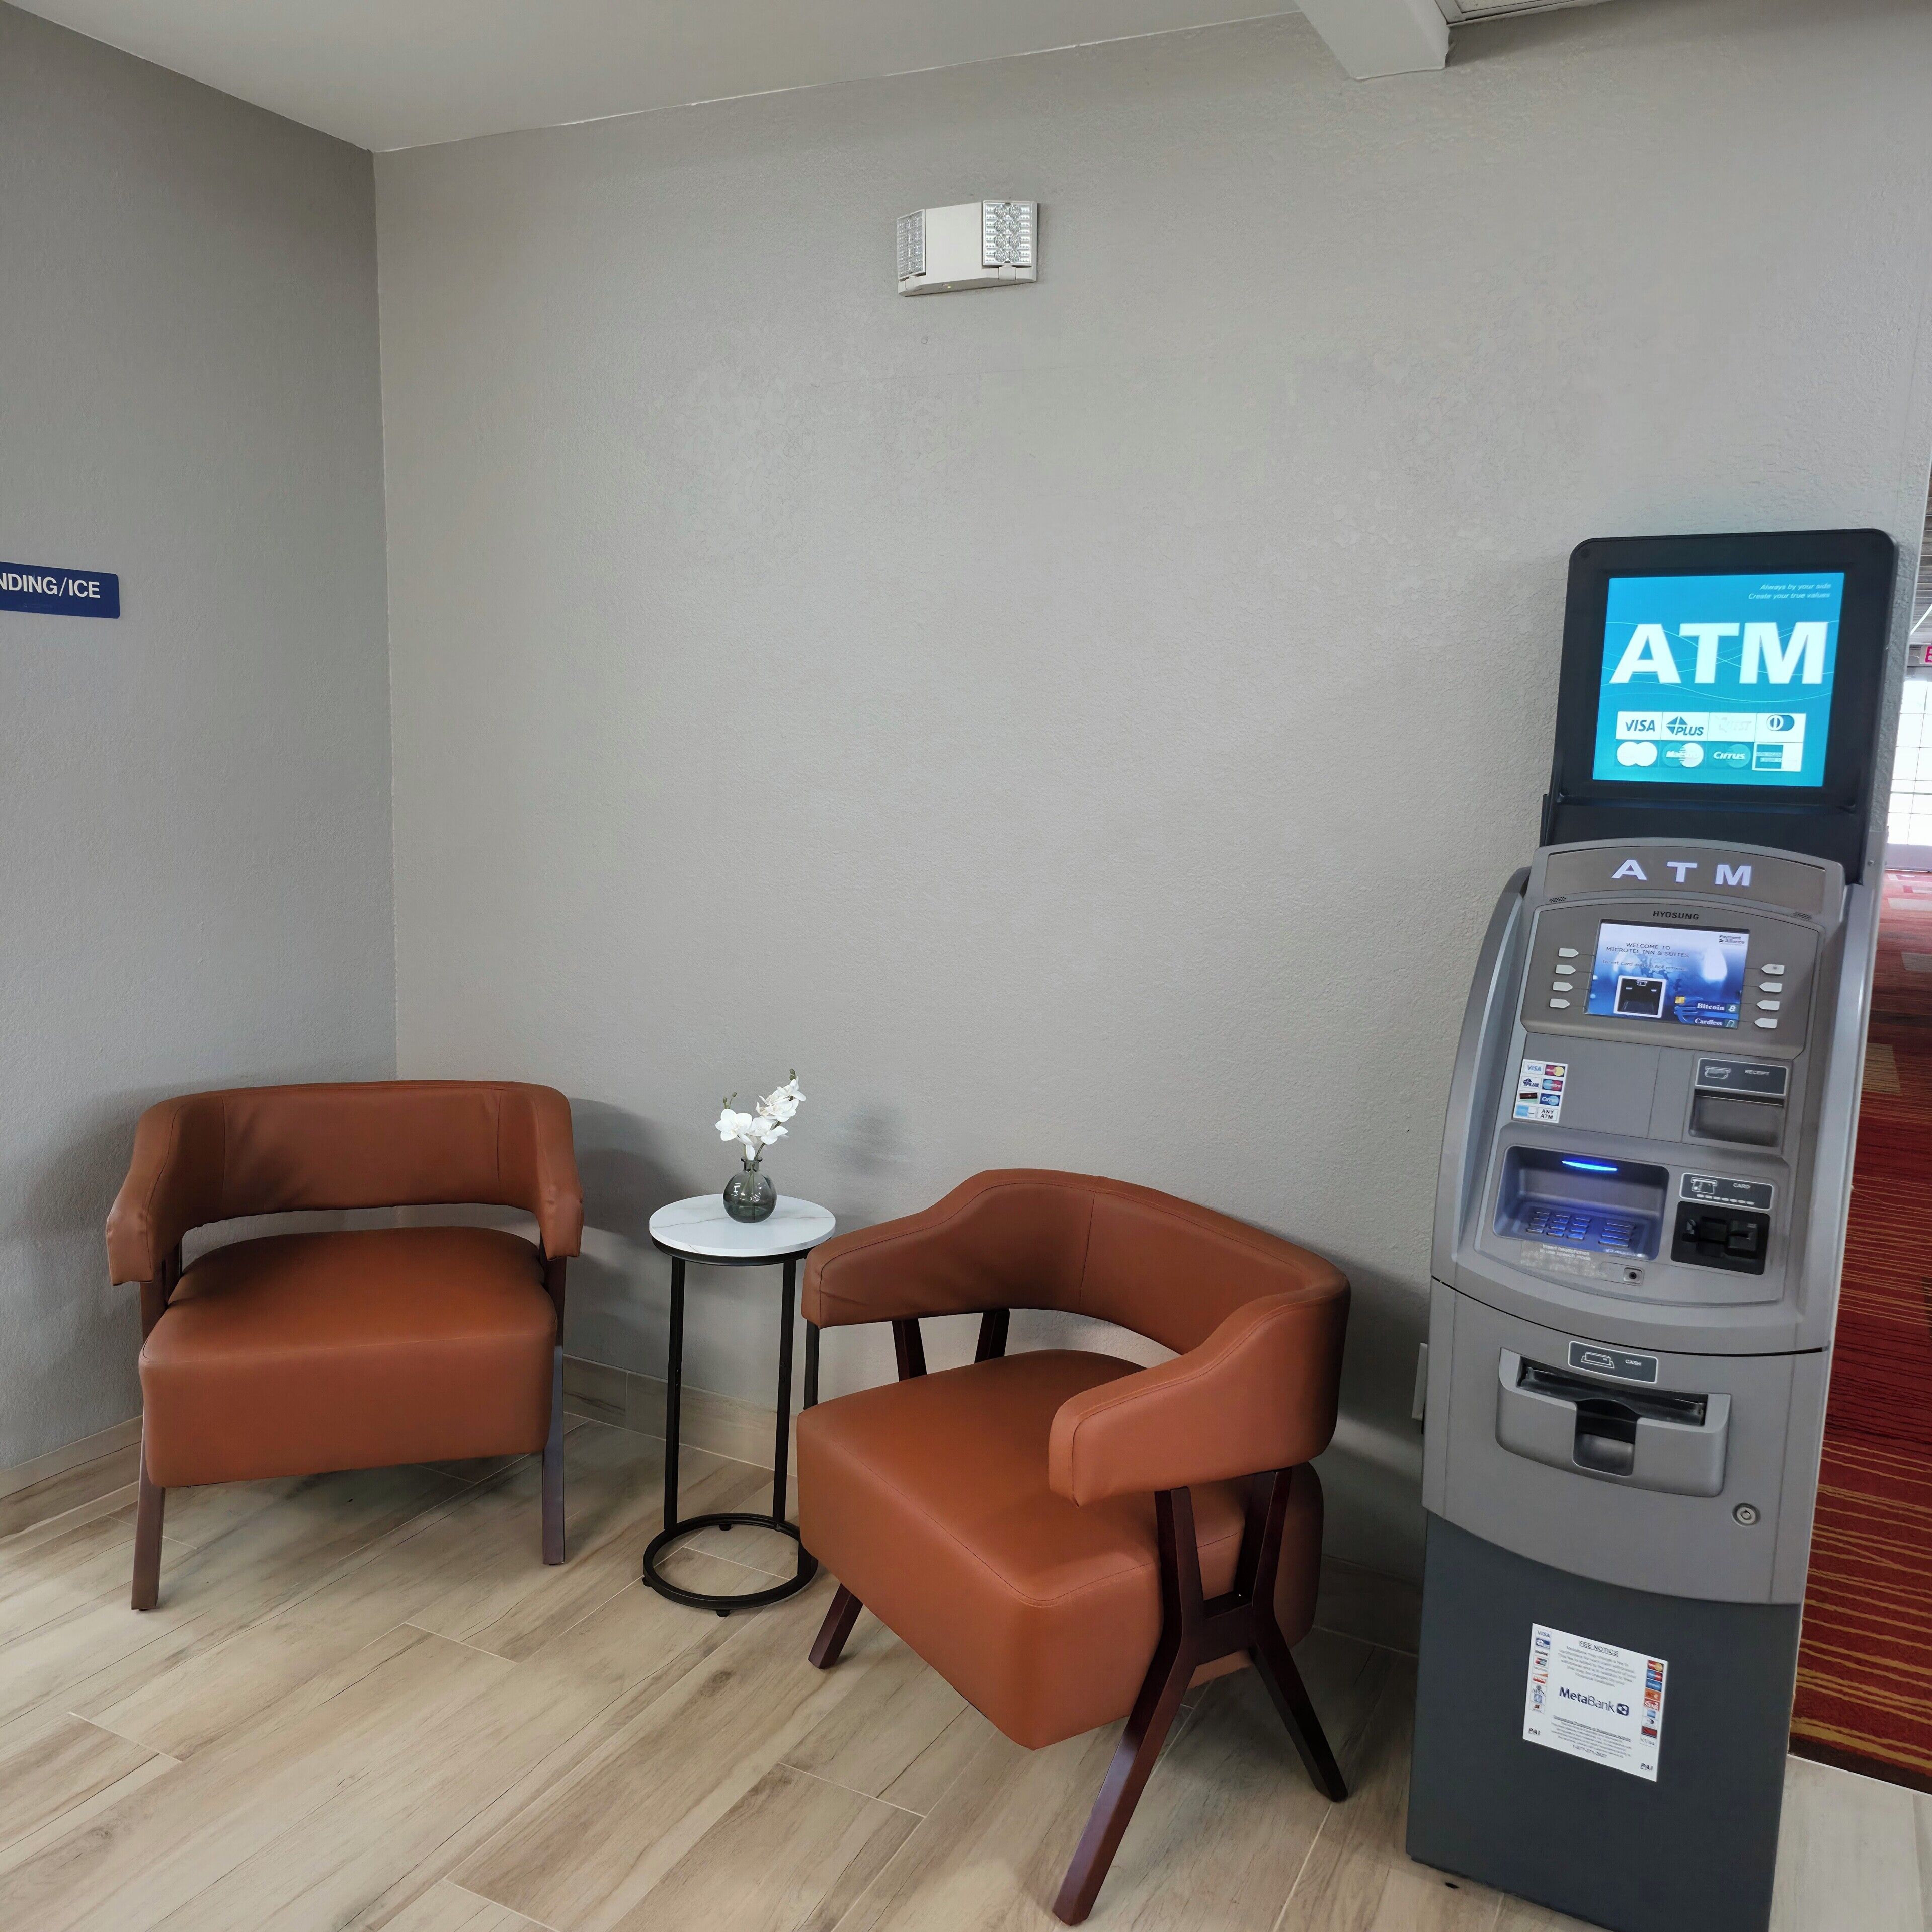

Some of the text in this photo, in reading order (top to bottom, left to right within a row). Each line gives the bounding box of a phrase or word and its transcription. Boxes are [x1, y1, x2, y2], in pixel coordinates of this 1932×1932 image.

[1609, 622, 1828, 684] ATM
[1625, 720, 1655, 732] VISA
[1675, 726, 1704, 736] PLUS
[1713, 751, 1745, 760] Cirrus
[1611, 859, 1751, 886] ATM
[1653, 911, 1699, 920] HYOSUNG
[1697, 1003, 1725, 1011] Bitcoin
[1593, 1644, 1619, 1656] NOTICE
[1559, 1686, 1615, 1713] MetaBank
